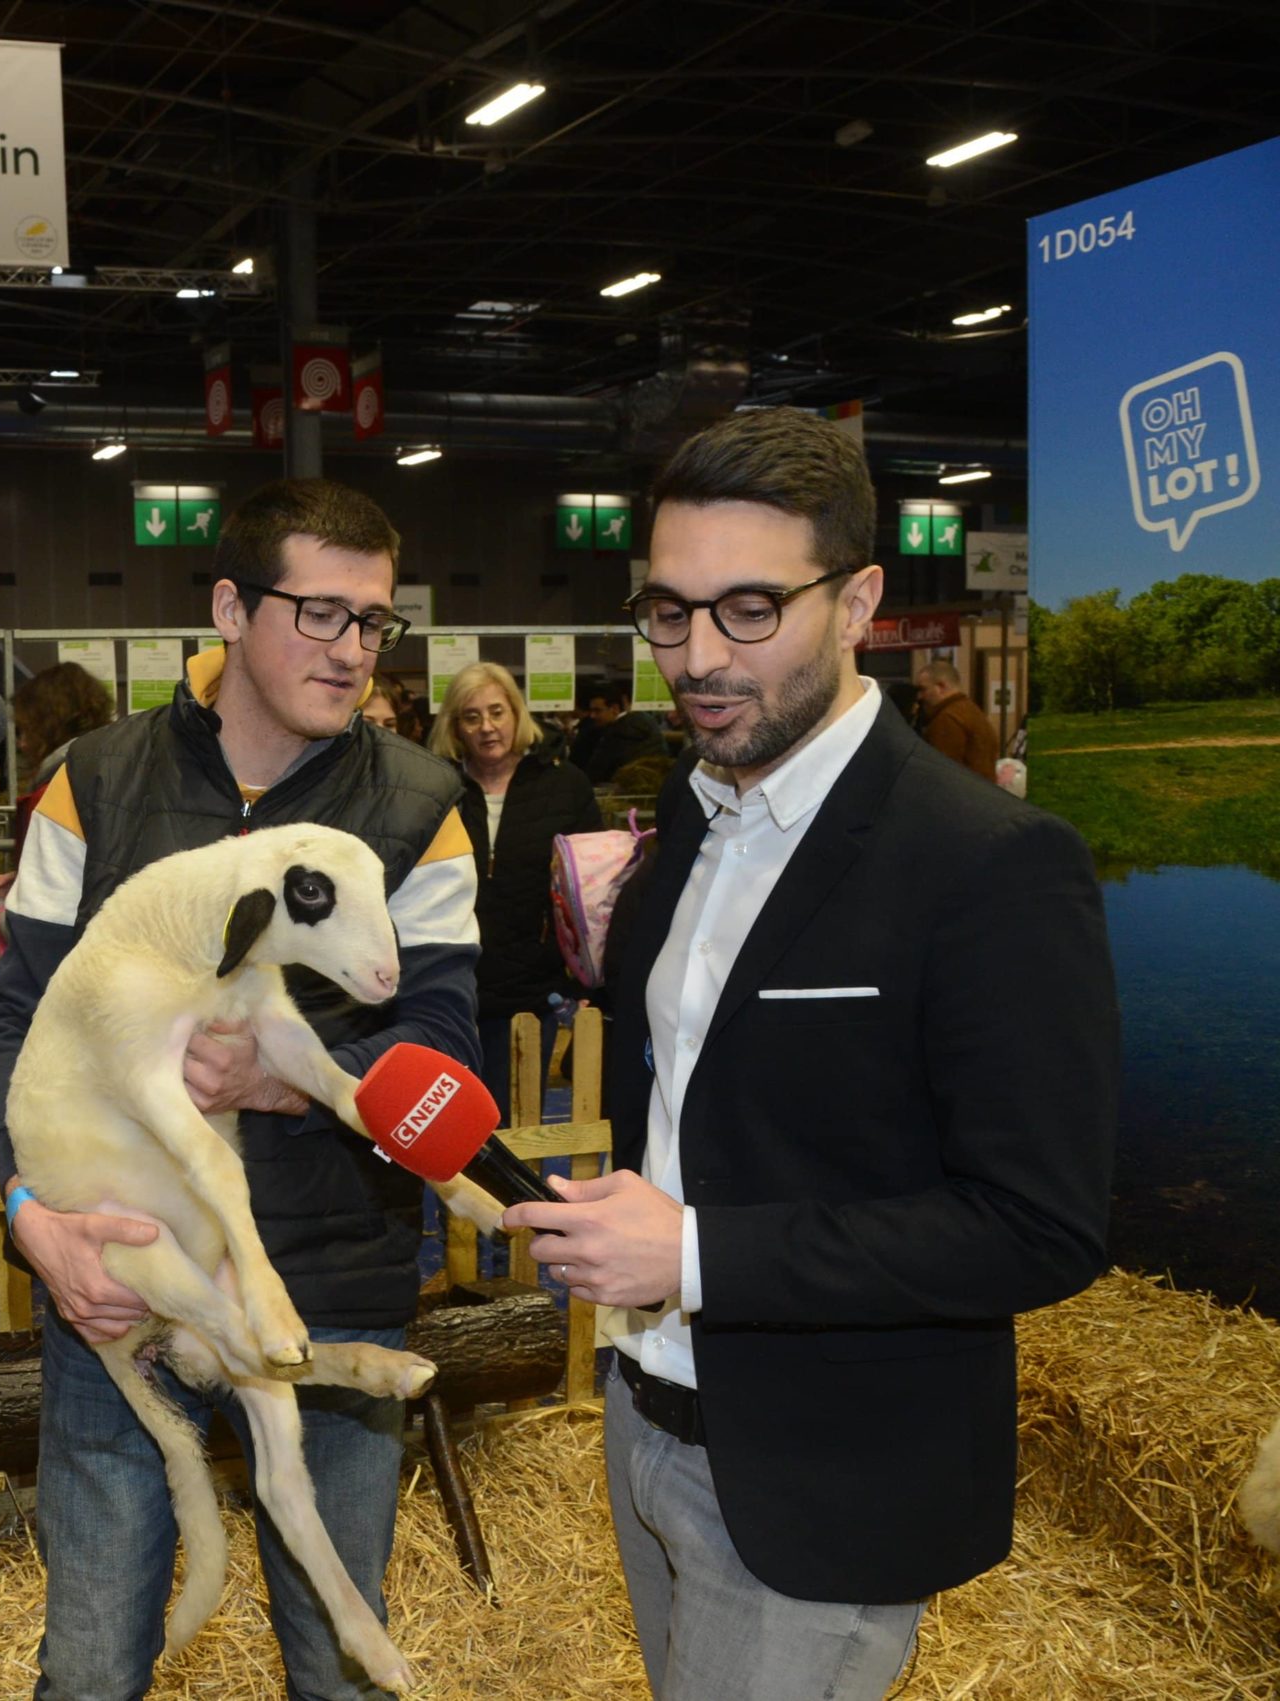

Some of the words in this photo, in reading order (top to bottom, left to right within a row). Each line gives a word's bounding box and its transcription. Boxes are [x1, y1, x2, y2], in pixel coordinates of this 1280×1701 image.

[1038, 210, 1136, 263] 1D054
[1142, 387, 1202, 432] OH
[1145, 423, 1207, 470] MY
[1148, 459, 1218, 506] LOT
